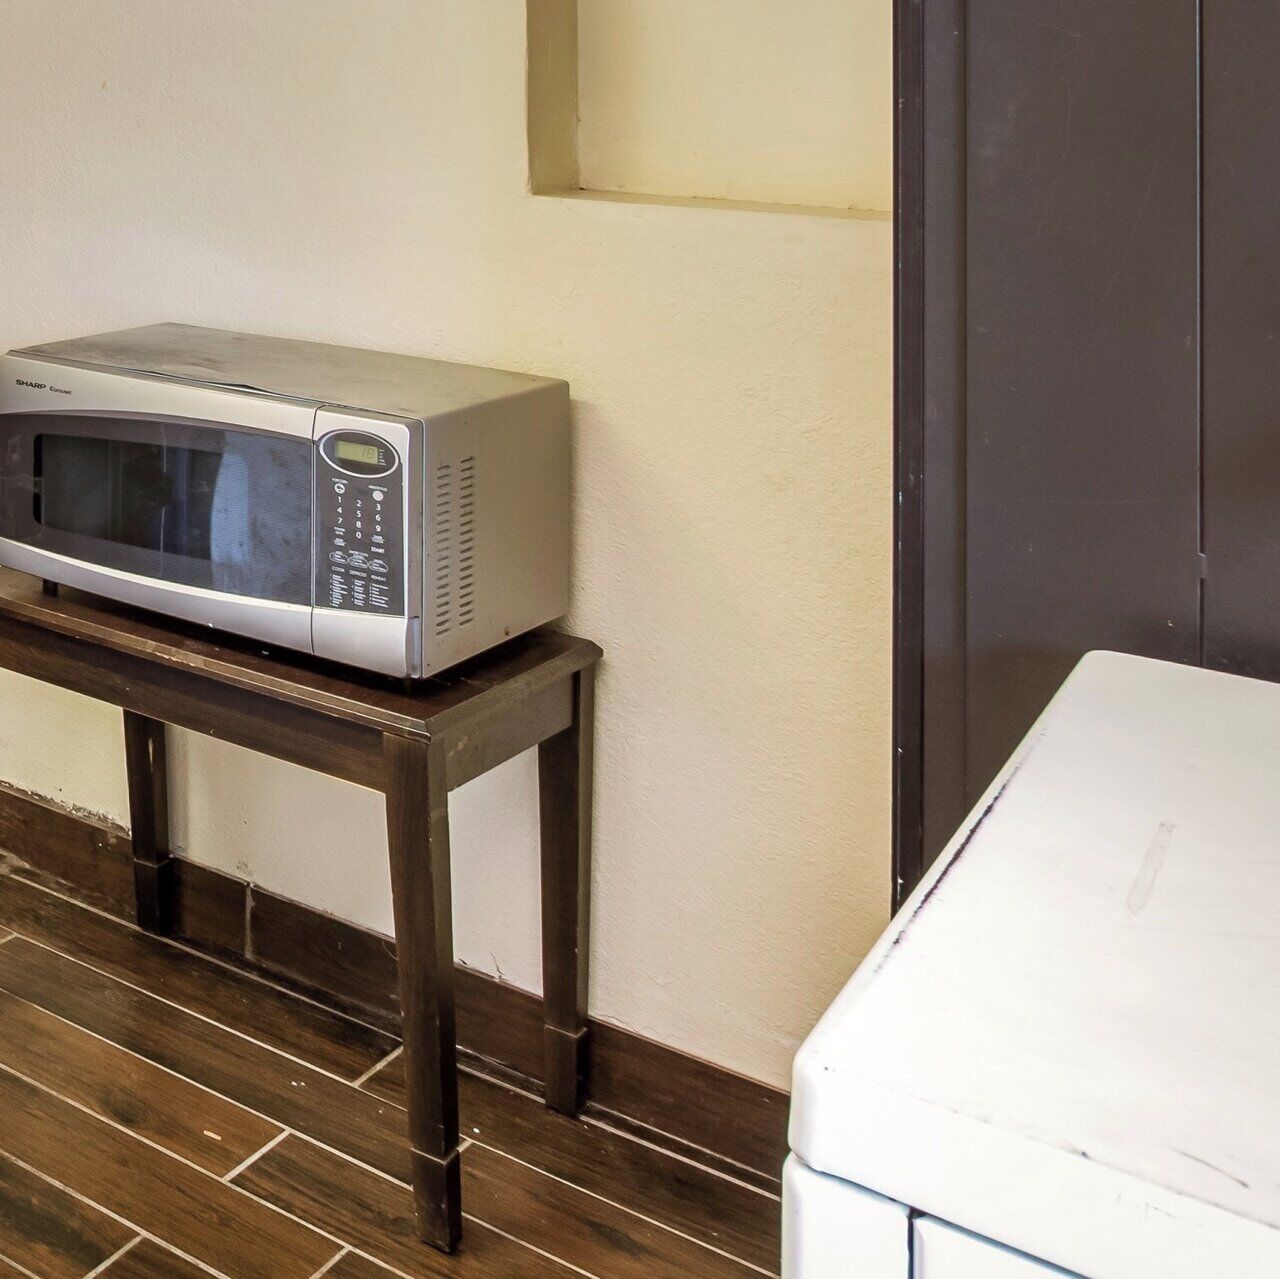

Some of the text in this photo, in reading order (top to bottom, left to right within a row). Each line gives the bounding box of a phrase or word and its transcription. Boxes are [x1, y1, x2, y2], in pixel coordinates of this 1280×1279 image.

[15, 379, 47, 389] SHARP
[356, 499, 362, 507] 2
[375, 503, 381, 511] 3
[336, 506, 342, 514] 4
[356, 510, 362, 518] 5
[356, 520, 362, 528] 8
[355, 531, 362, 539] 0
